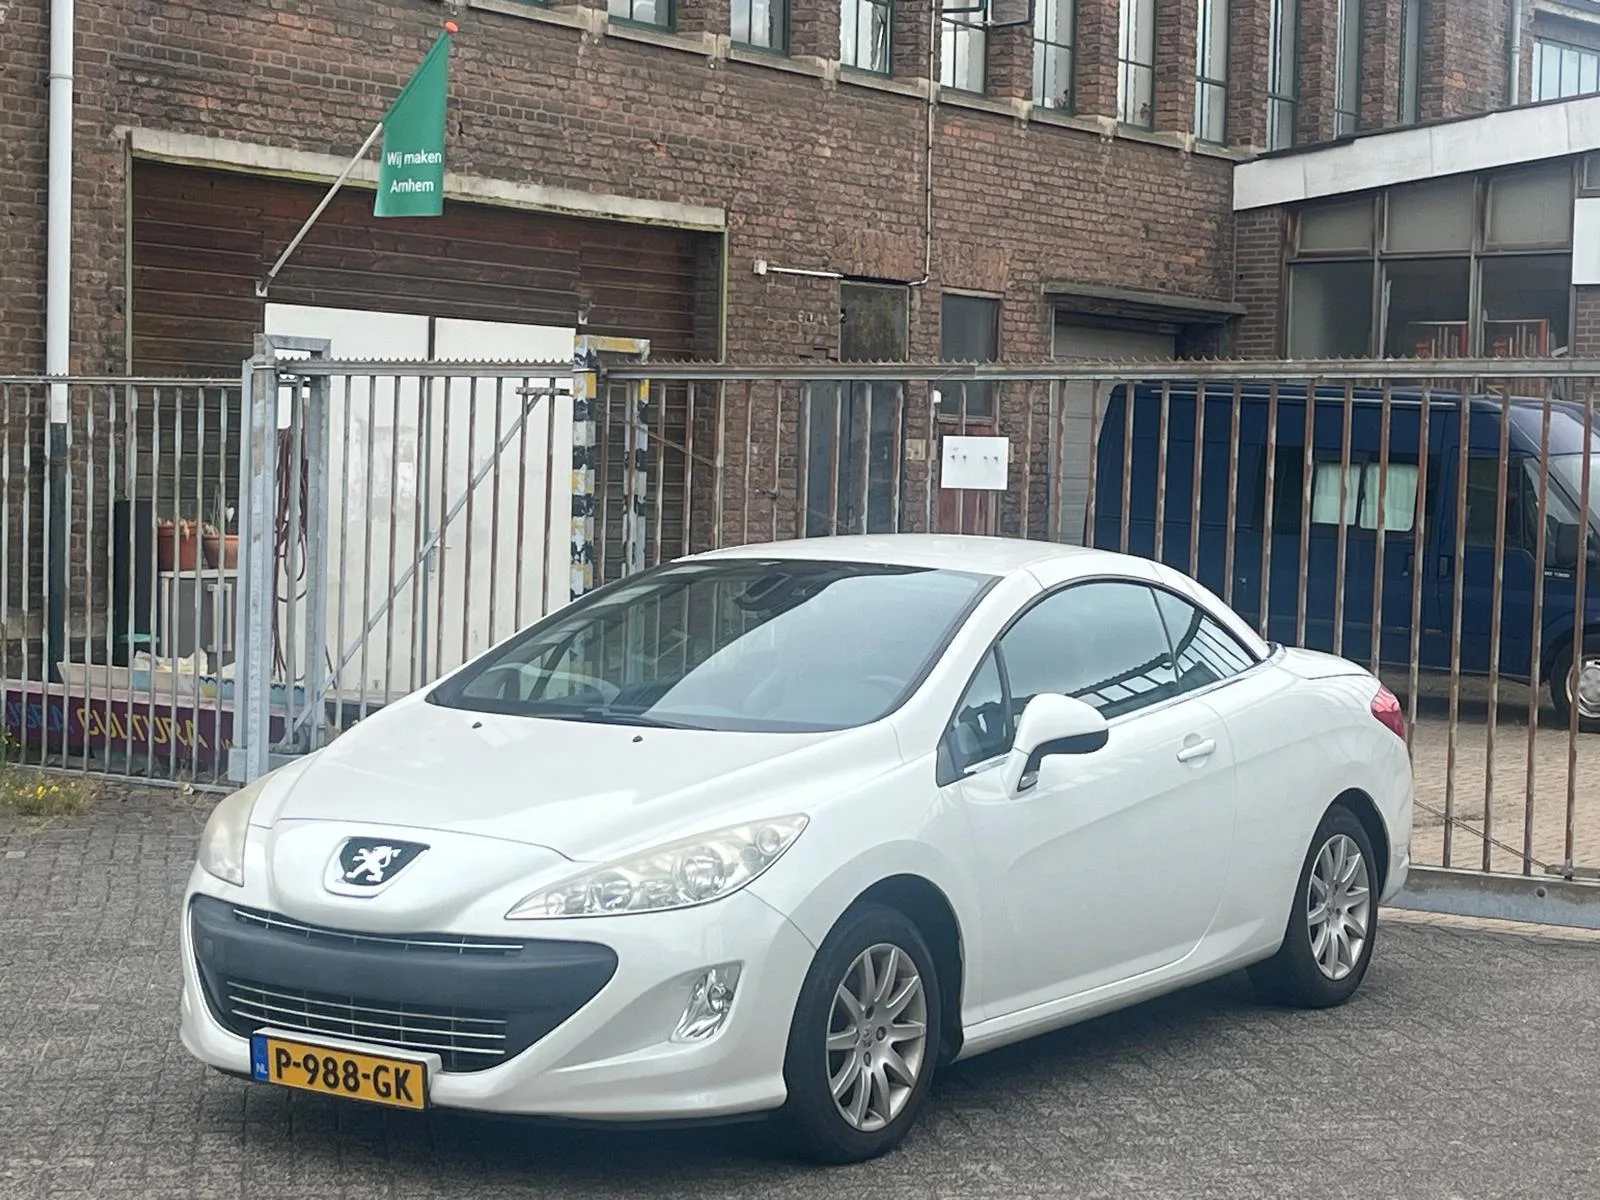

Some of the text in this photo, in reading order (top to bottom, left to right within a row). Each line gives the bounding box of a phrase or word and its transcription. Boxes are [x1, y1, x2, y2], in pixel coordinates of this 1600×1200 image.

[387, 148, 442, 169] Wij maken
[389, 178, 435, 194] Arnhem
[256, 1047, 414, 1102] NL P-988-GK
